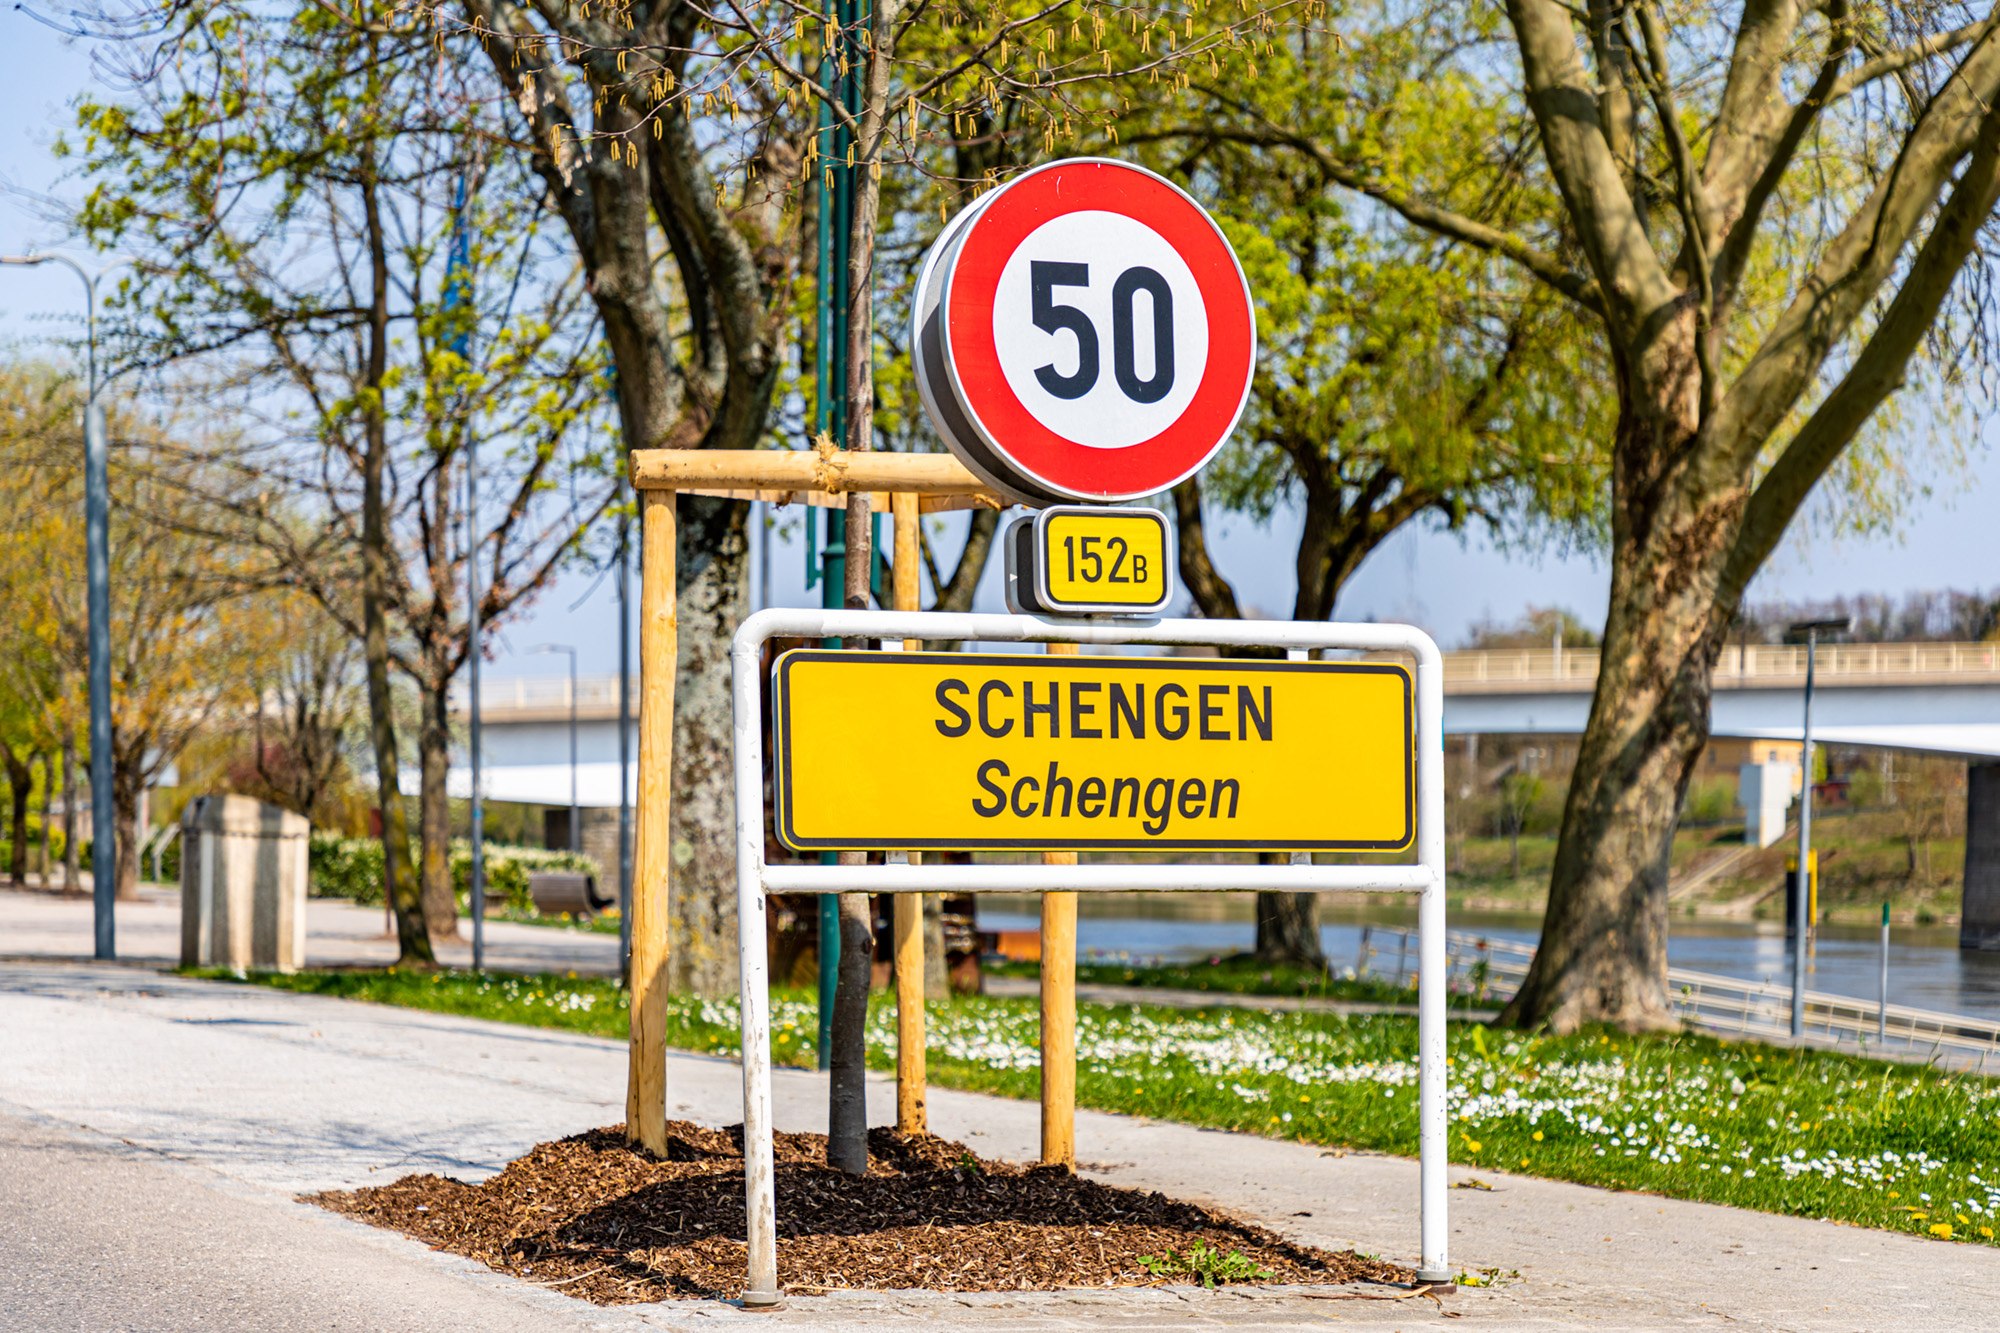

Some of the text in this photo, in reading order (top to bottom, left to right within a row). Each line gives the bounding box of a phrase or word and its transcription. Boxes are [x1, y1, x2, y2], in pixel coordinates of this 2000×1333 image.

[1030, 260, 1176, 404] 50
[1063, 535, 1148, 584] 152B
[935, 678, 1273, 742] SCHENGEN
[972, 759, 1240, 836] Schengen
